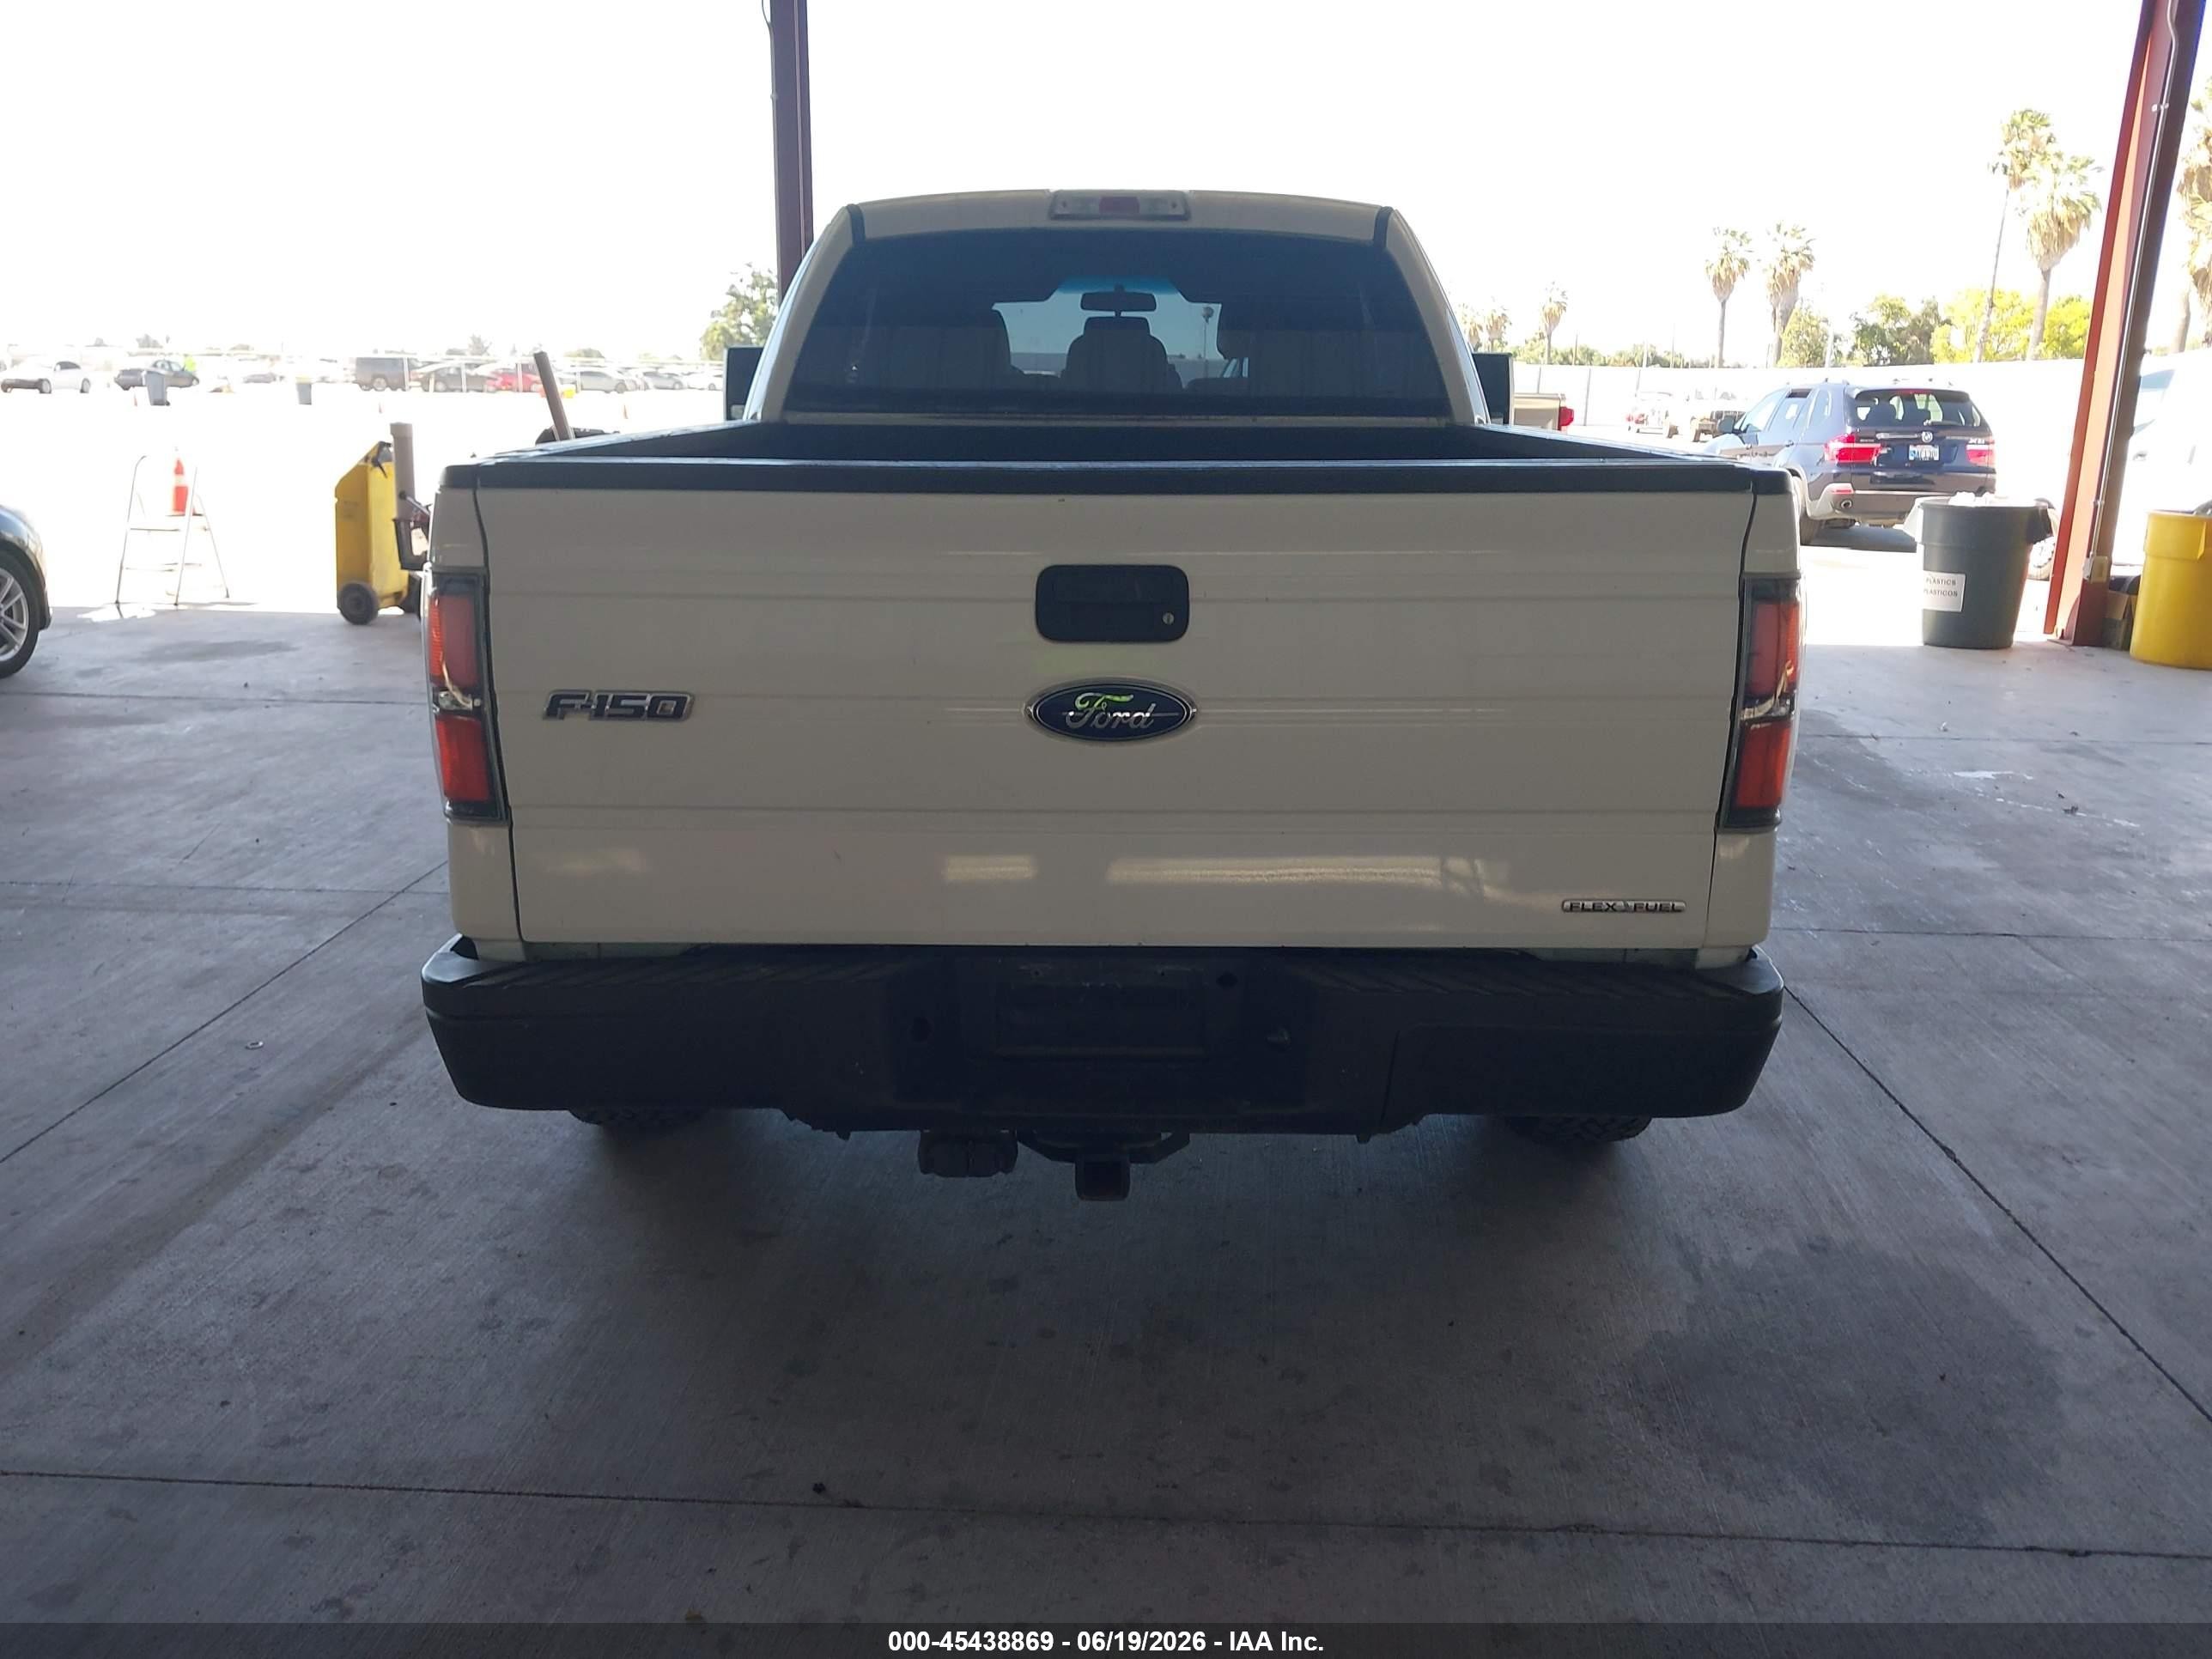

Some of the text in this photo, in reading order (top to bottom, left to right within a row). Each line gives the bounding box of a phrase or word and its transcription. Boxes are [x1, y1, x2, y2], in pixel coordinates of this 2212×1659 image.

[544, 690, 694, 720] F-150
[1066, 692, 1156, 728] Ford
[1569, 901, 1685, 913] FLEX FUEL
